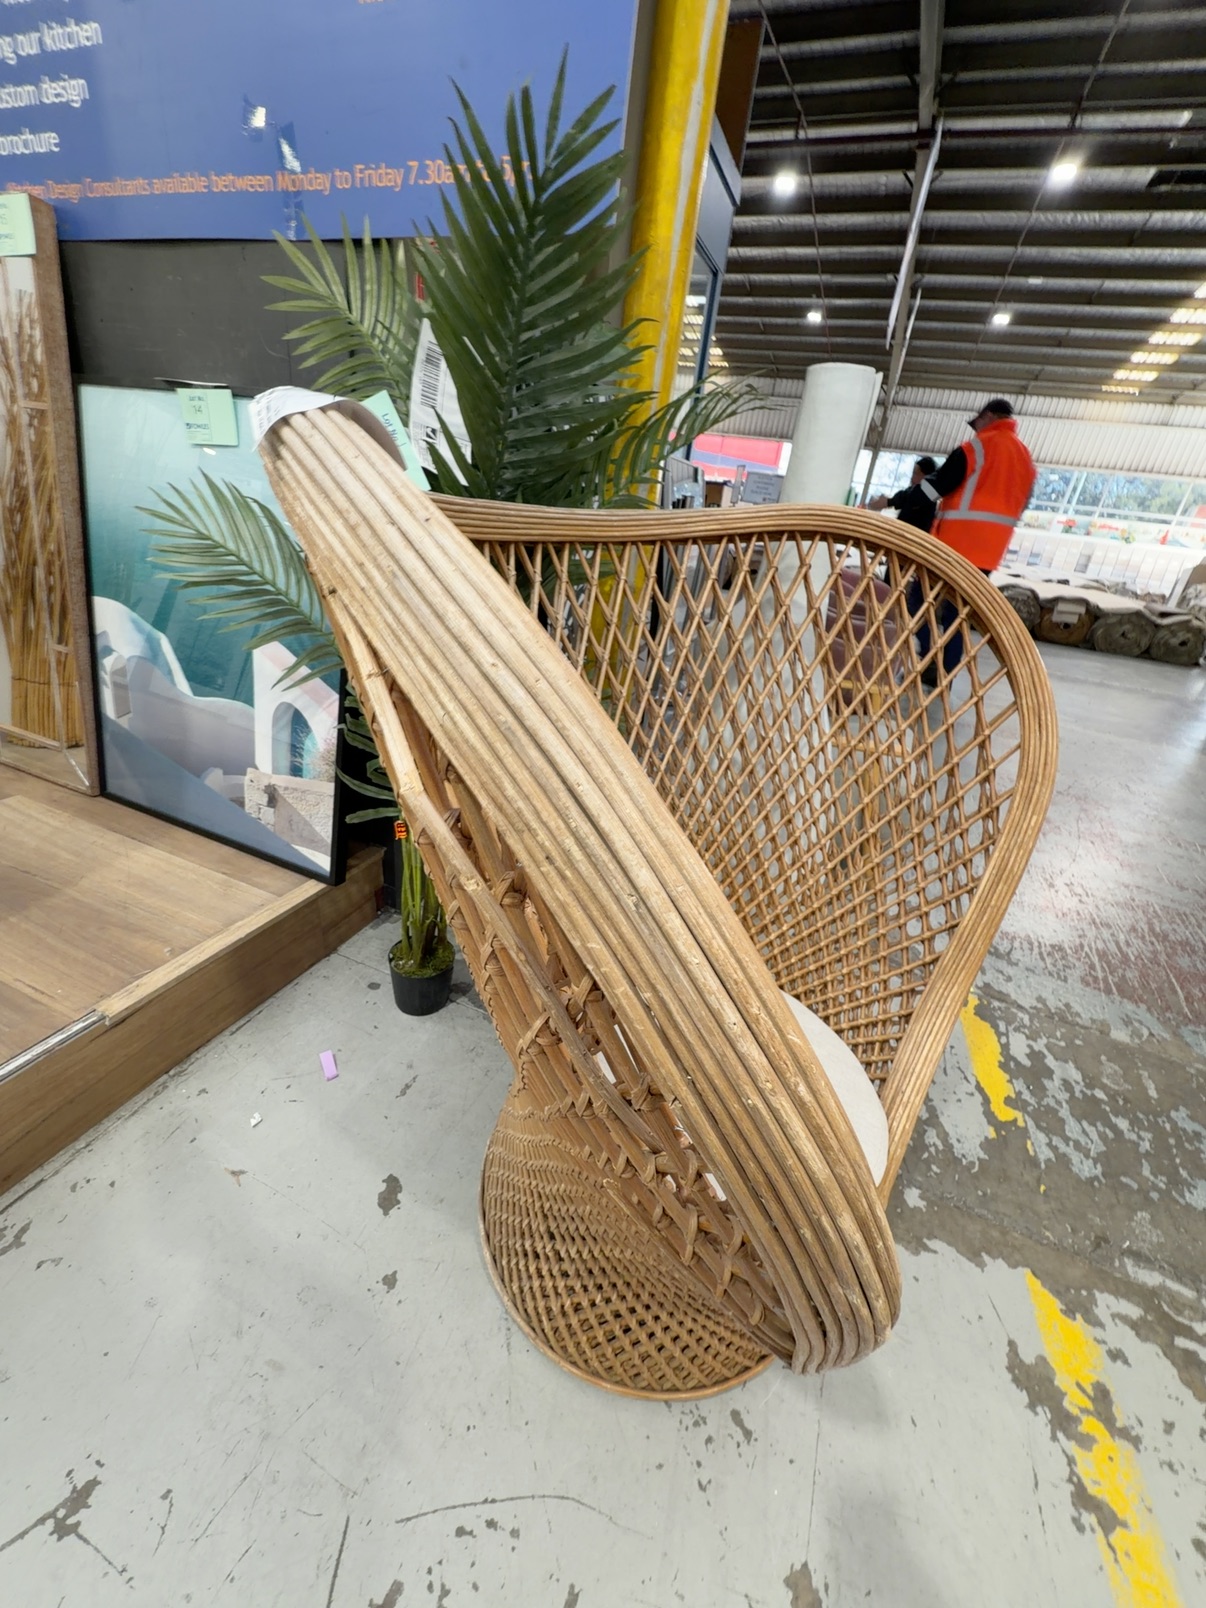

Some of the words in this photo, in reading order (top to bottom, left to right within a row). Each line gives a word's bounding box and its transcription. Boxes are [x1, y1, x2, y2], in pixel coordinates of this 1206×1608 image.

[14, 32, 41, 56] our
[39, 17, 103, 52] kitchen
[39, 73, 89, 108] design
[46, 179, 82, 203] Design
[84, 177, 150, 198] Consultants
[152, 171, 208, 195] available
[209, 171, 274, 194] between
[276, 167, 331, 196] Monday
[334, 168, 351, 190] to
[354, 163, 404, 192] Friday
[381, 412, 394, 428] Lot
